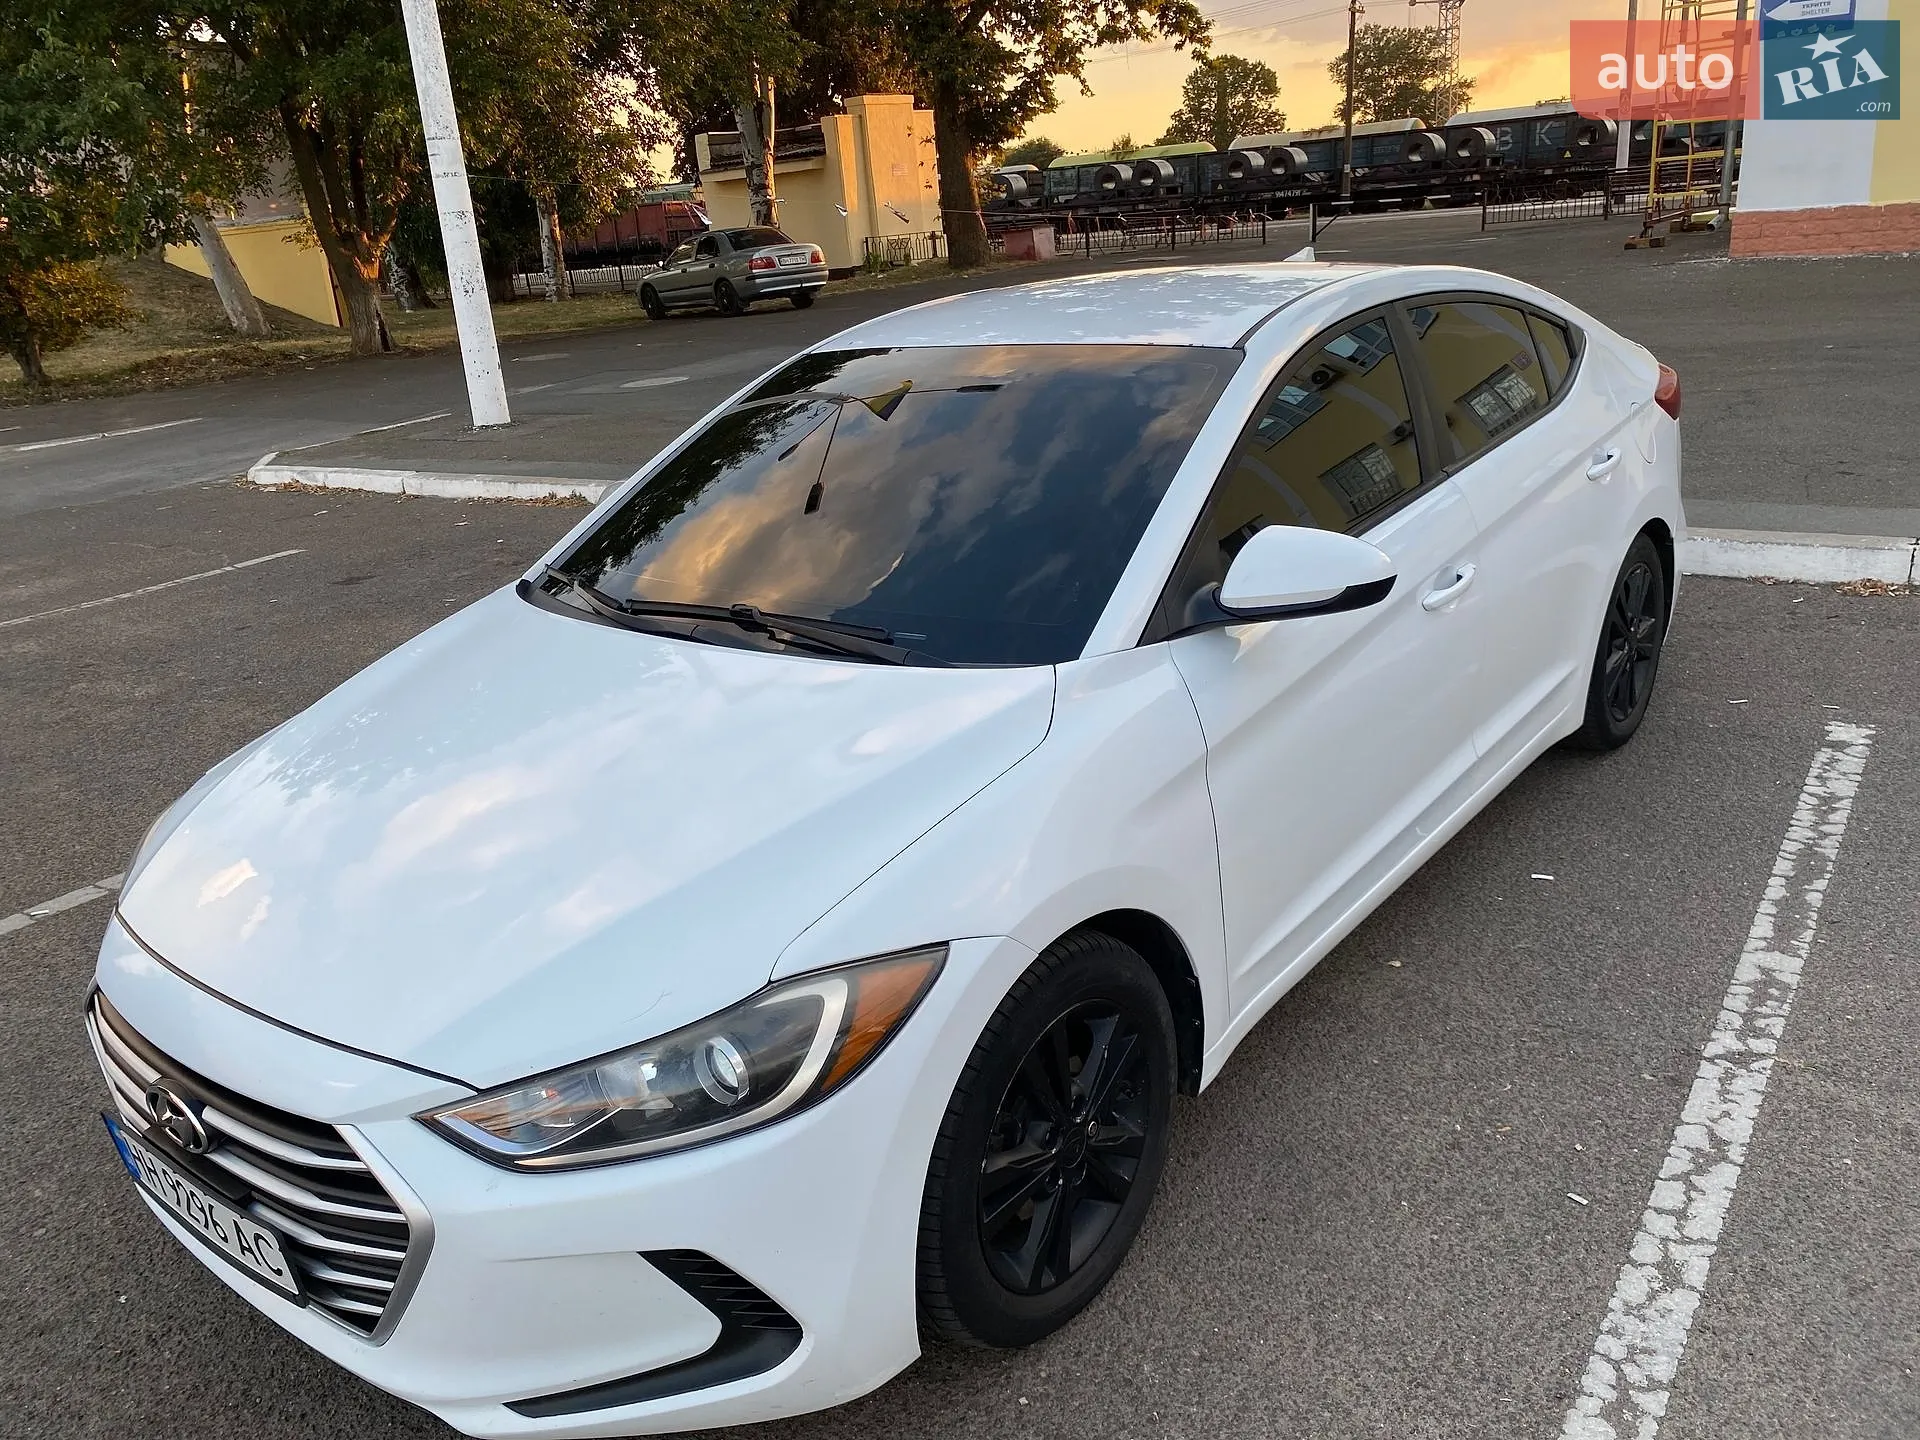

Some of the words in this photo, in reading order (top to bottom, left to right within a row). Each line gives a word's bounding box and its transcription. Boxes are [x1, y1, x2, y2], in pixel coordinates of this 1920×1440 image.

[1801, 8, 1830, 17] SHELTER
[162, 1168, 229, 1244] 9296
[233, 1219, 283, 1277] AC
